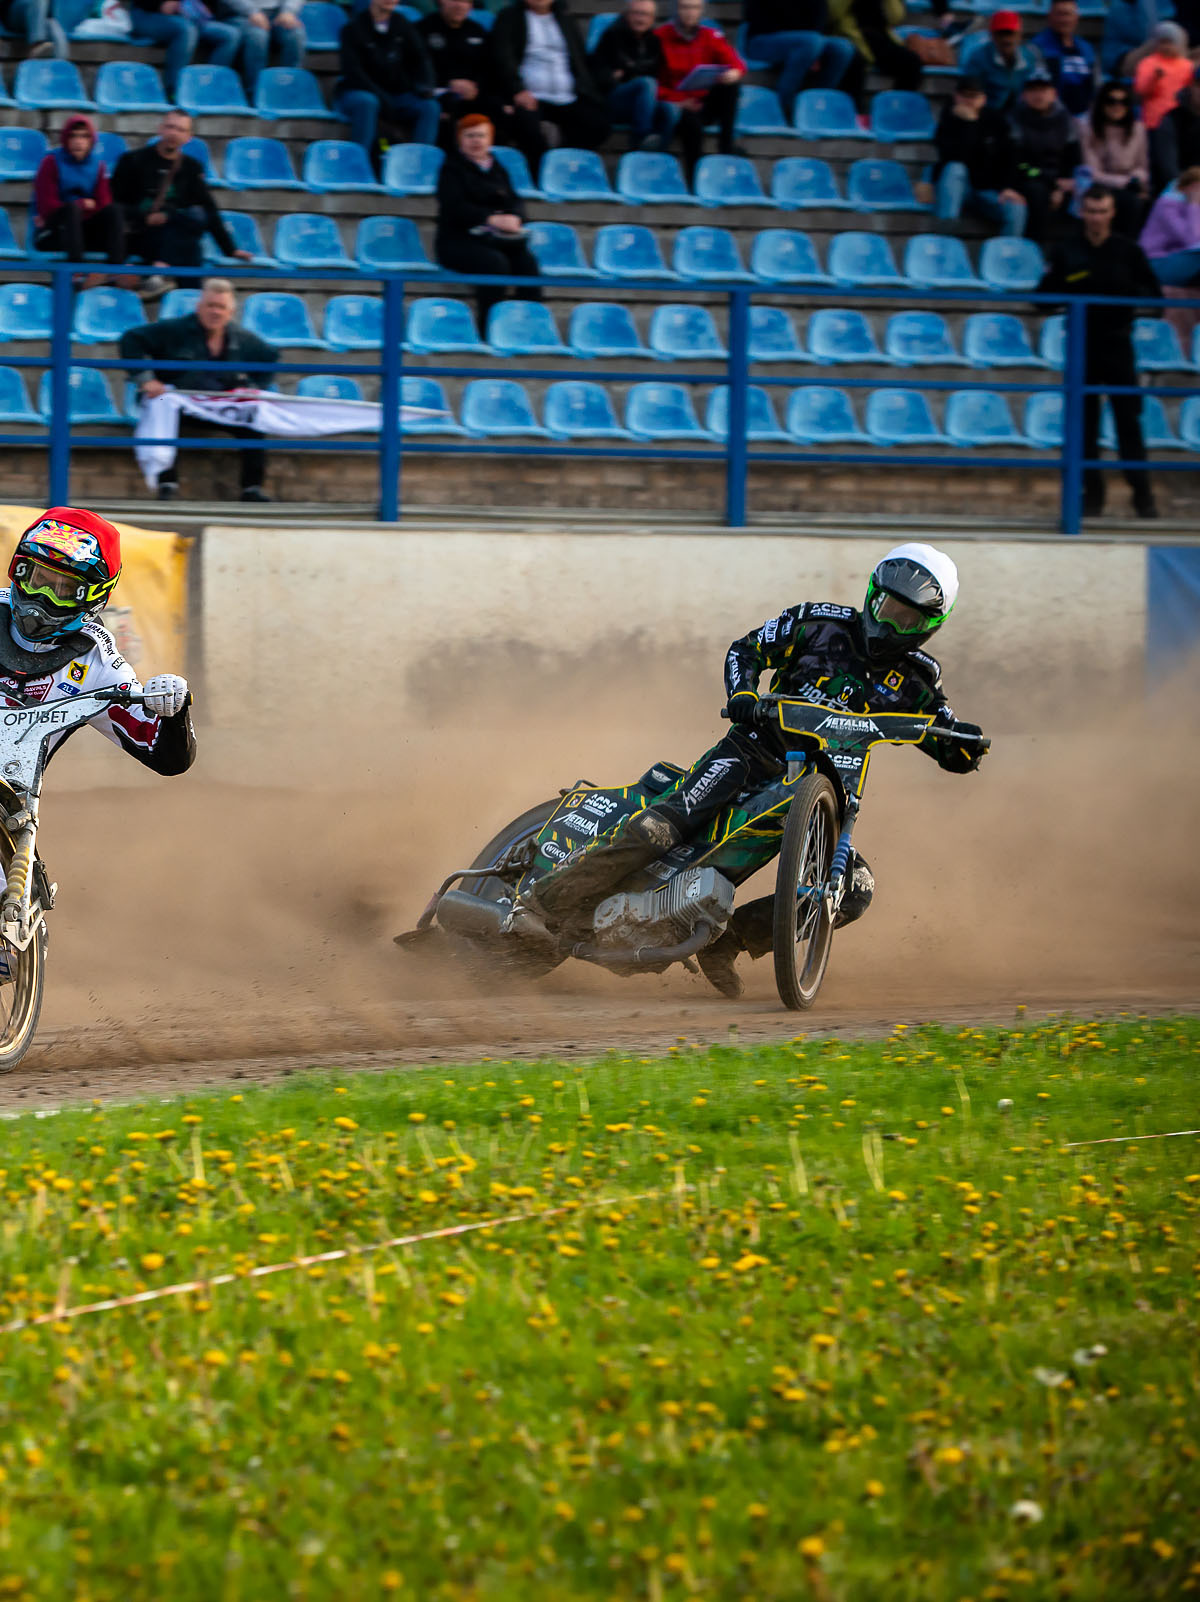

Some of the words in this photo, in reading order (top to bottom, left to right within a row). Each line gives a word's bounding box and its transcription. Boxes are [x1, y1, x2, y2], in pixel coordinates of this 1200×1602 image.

[3, 710, 69, 726] OPTIBET
[682, 757, 740, 816] METALIKA
[697, 767, 730, 801] RECYCLING
